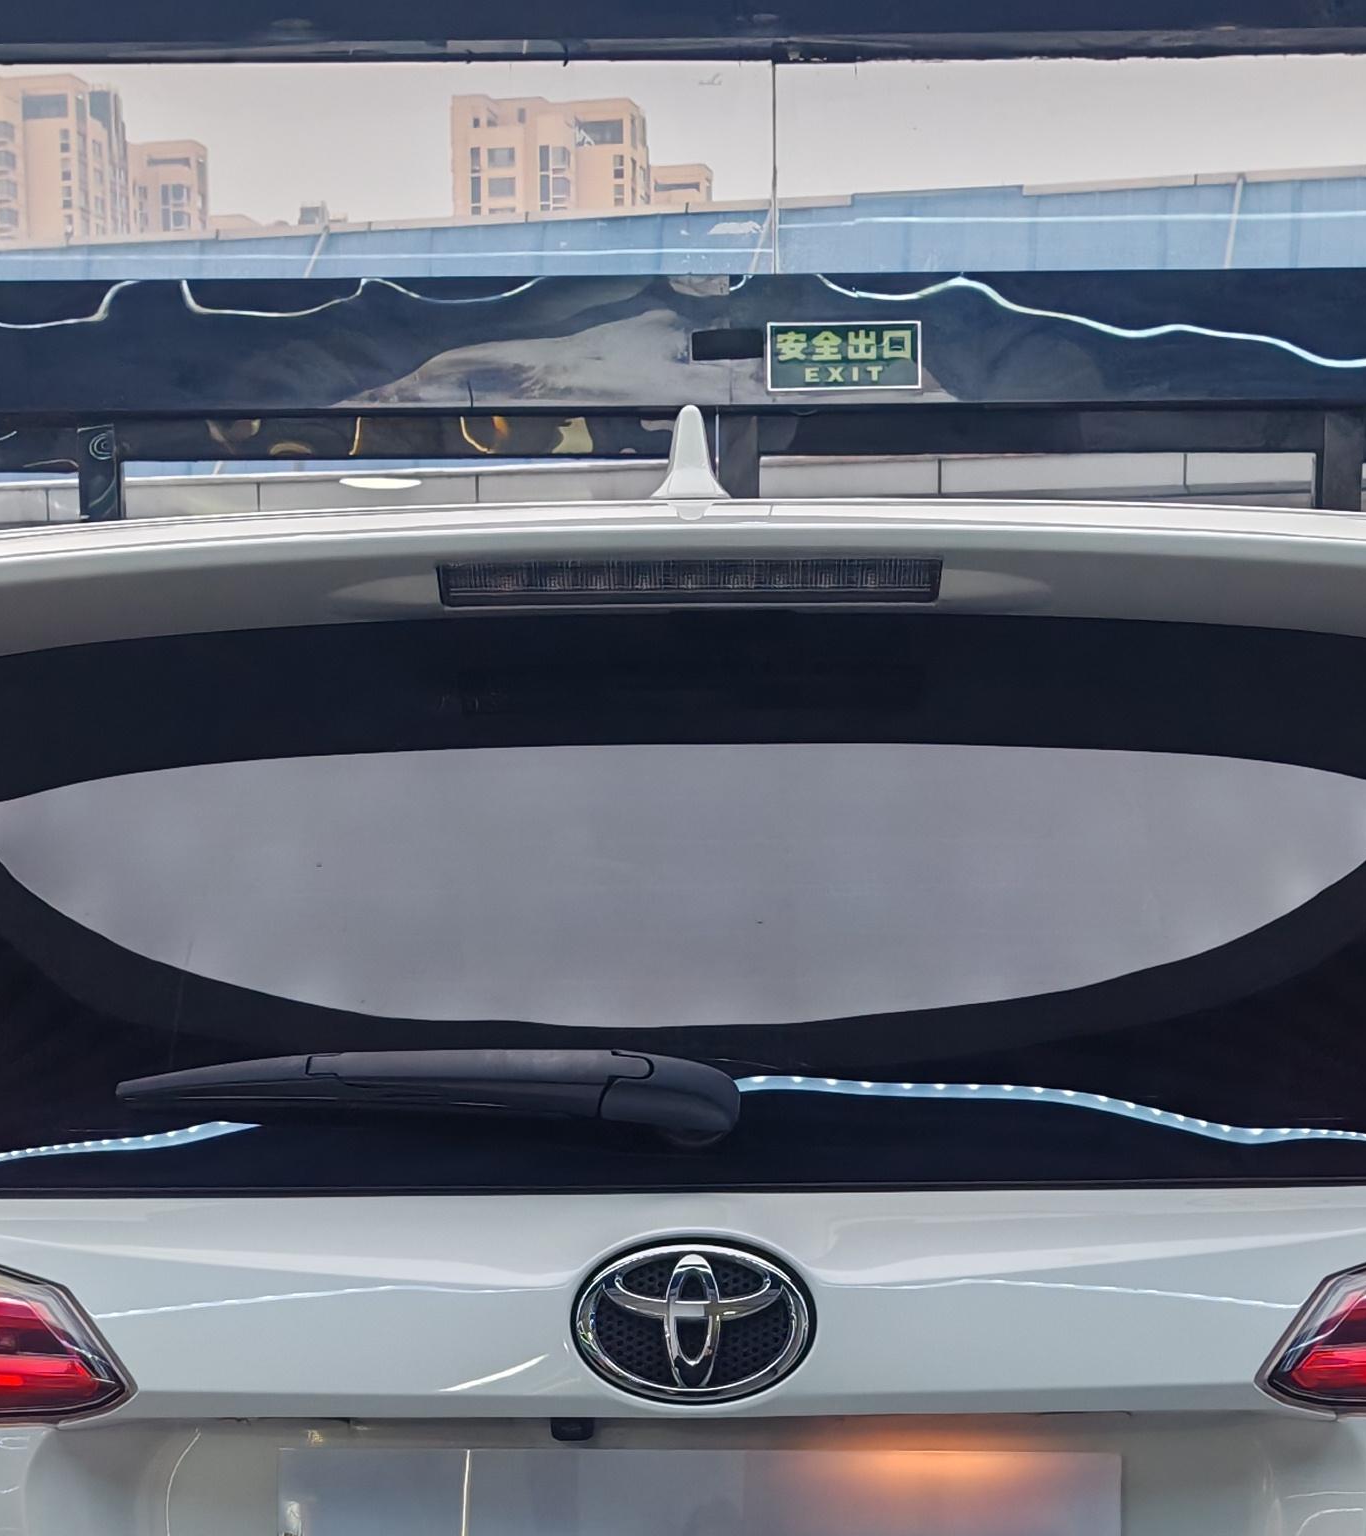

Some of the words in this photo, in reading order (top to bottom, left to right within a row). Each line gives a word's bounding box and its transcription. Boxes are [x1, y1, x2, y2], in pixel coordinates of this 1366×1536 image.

[776, 329, 912, 361] 安全出口
[804, 366, 883, 383] EXIT
